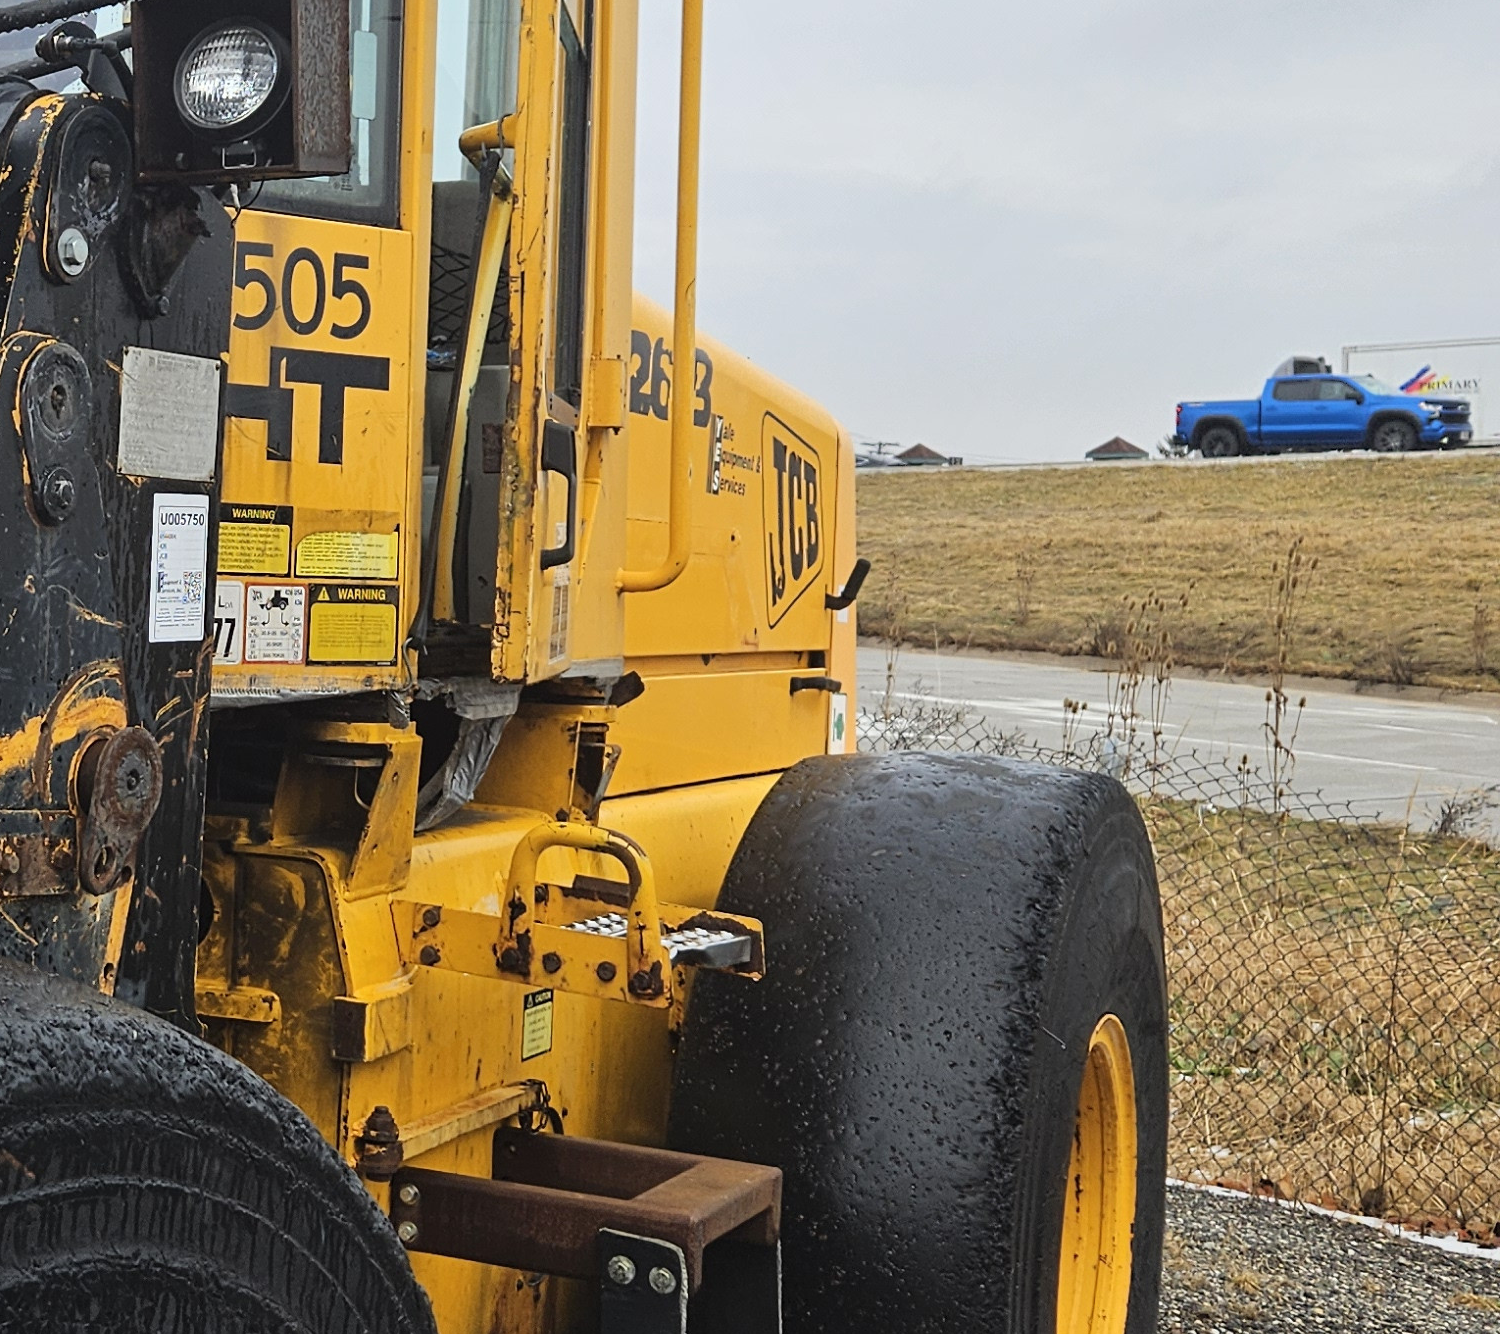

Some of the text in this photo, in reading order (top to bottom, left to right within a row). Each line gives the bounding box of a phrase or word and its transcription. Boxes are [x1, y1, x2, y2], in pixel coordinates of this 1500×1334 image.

[233, 241, 371, 340] 505
[1419, 378, 1481, 391] PRIMARY
[711, 469, 746, 497] Services
[160, 513, 205, 526] U005750
[232, 508, 275, 520] WARNING
[770, 436, 820, 608] JCB
[337, 588, 386, 600] WARNING
